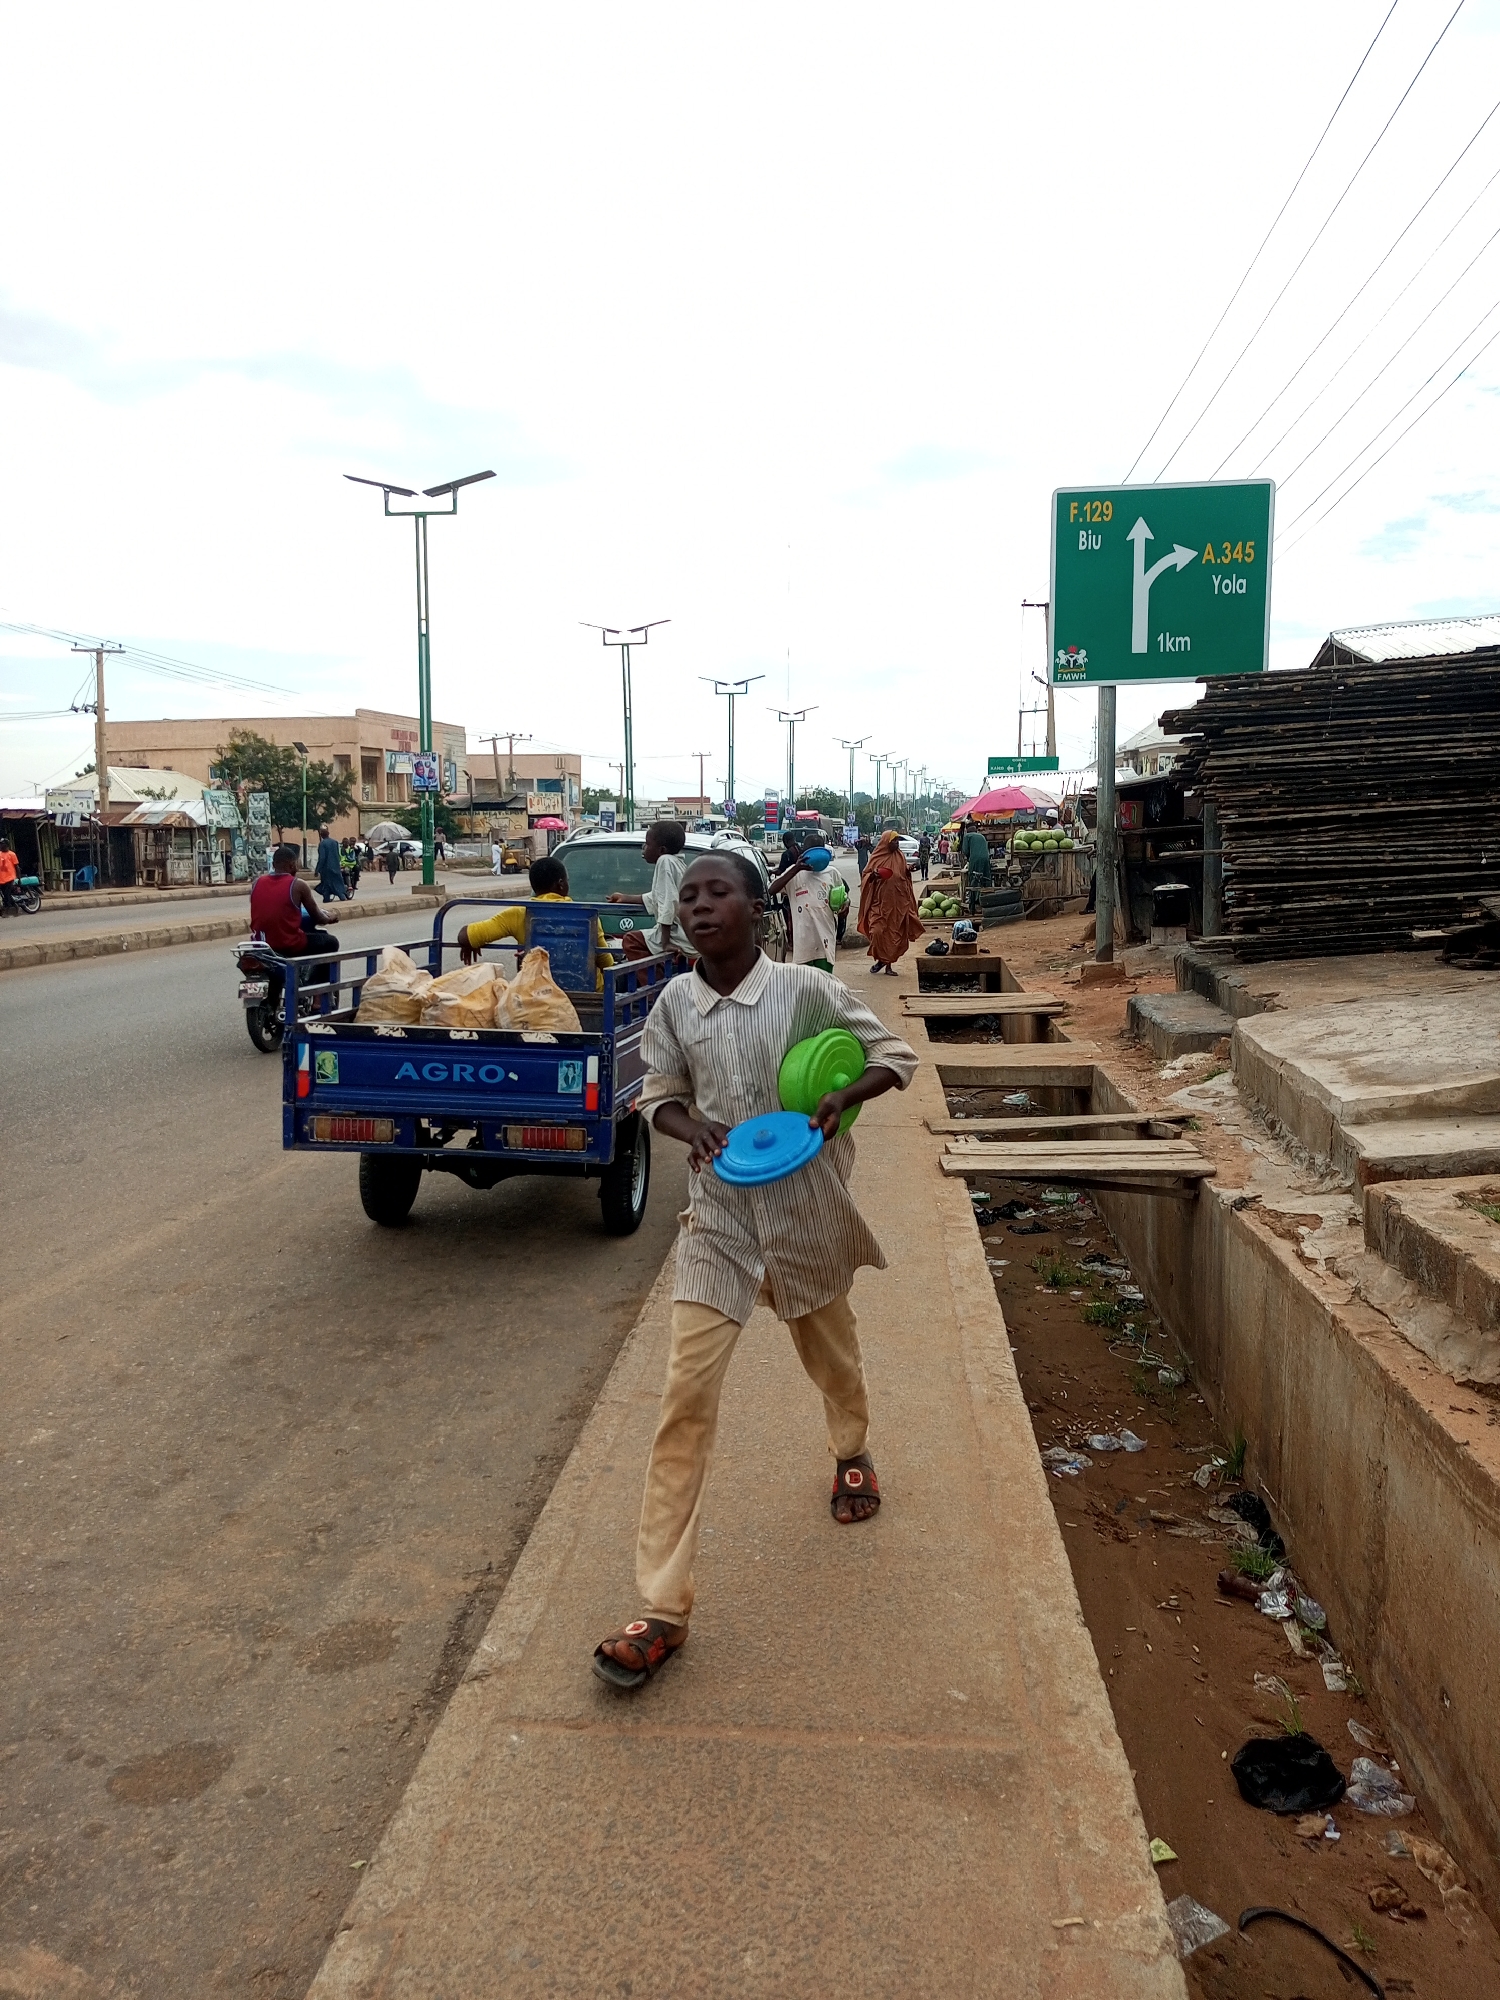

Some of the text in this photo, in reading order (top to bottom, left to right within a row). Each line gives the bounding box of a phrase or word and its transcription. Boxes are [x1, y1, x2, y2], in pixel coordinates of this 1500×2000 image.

[1069, 500, 1113, 523] F.129
[1078, 529, 1102, 551] Biu
[1201, 541, 1255, 564] A.345
[1211, 574, 1247, 595] Yola
[1157, 632, 1191, 653] 1km
[1057, 672, 1087, 681] FMWH
[394, 1061, 506, 1084] AGRO
